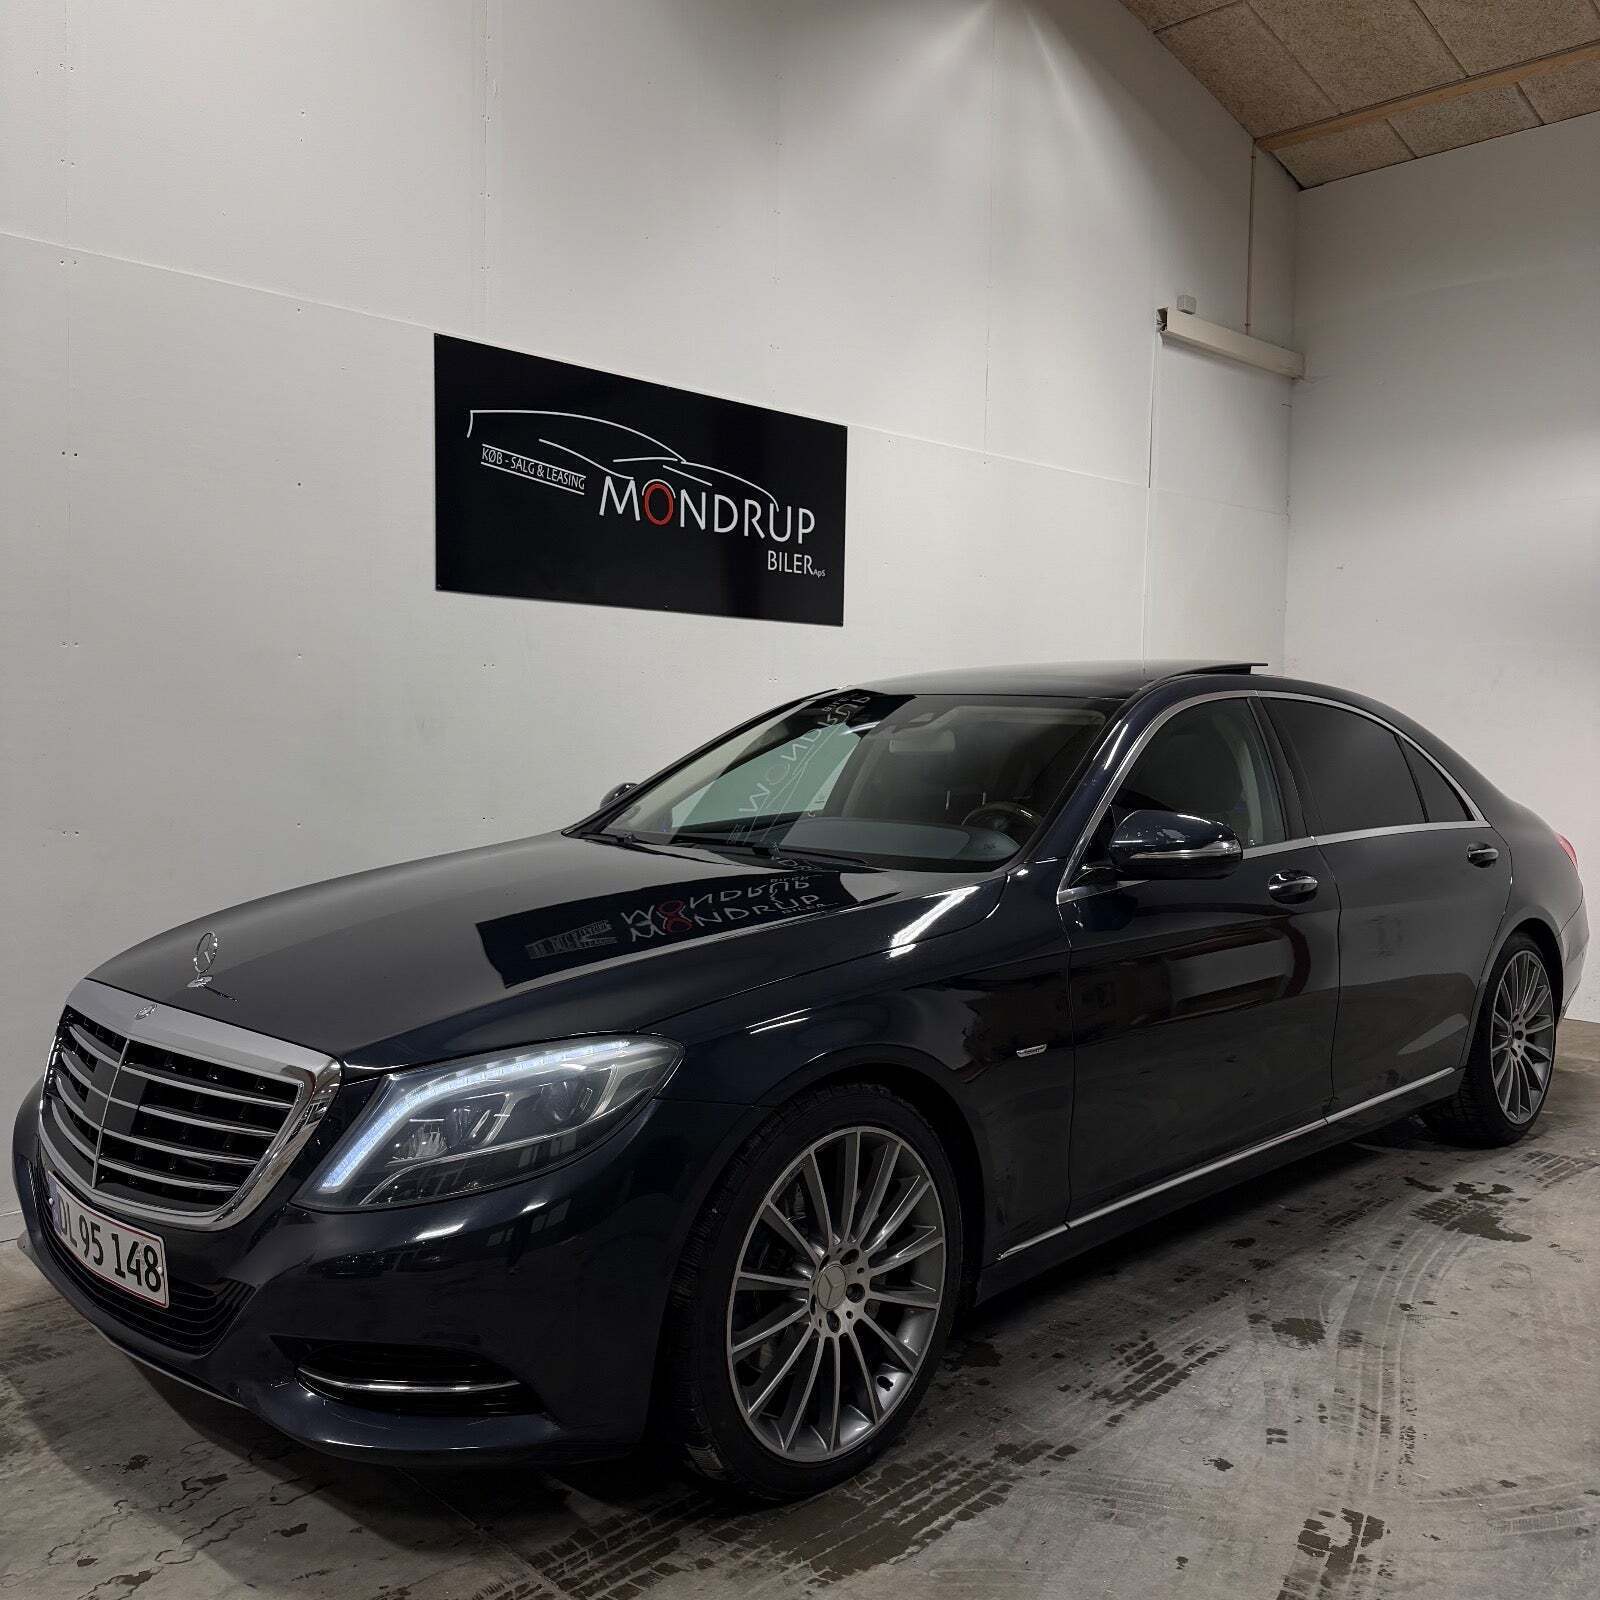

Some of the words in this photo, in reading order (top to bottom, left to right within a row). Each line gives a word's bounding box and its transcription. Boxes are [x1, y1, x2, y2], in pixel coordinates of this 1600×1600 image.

[481, 447, 503, 465] KØB
[510, 456, 535, 475] SALG
[536, 464, 545, 478] &
[546, 467, 585, 490] LEASING
[599, 475, 816, 545] MONDRUP
[767, 549, 814, 575] BILER
[78, 1214, 104, 1266] 95
[111, 1232, 162, 1293] 148
